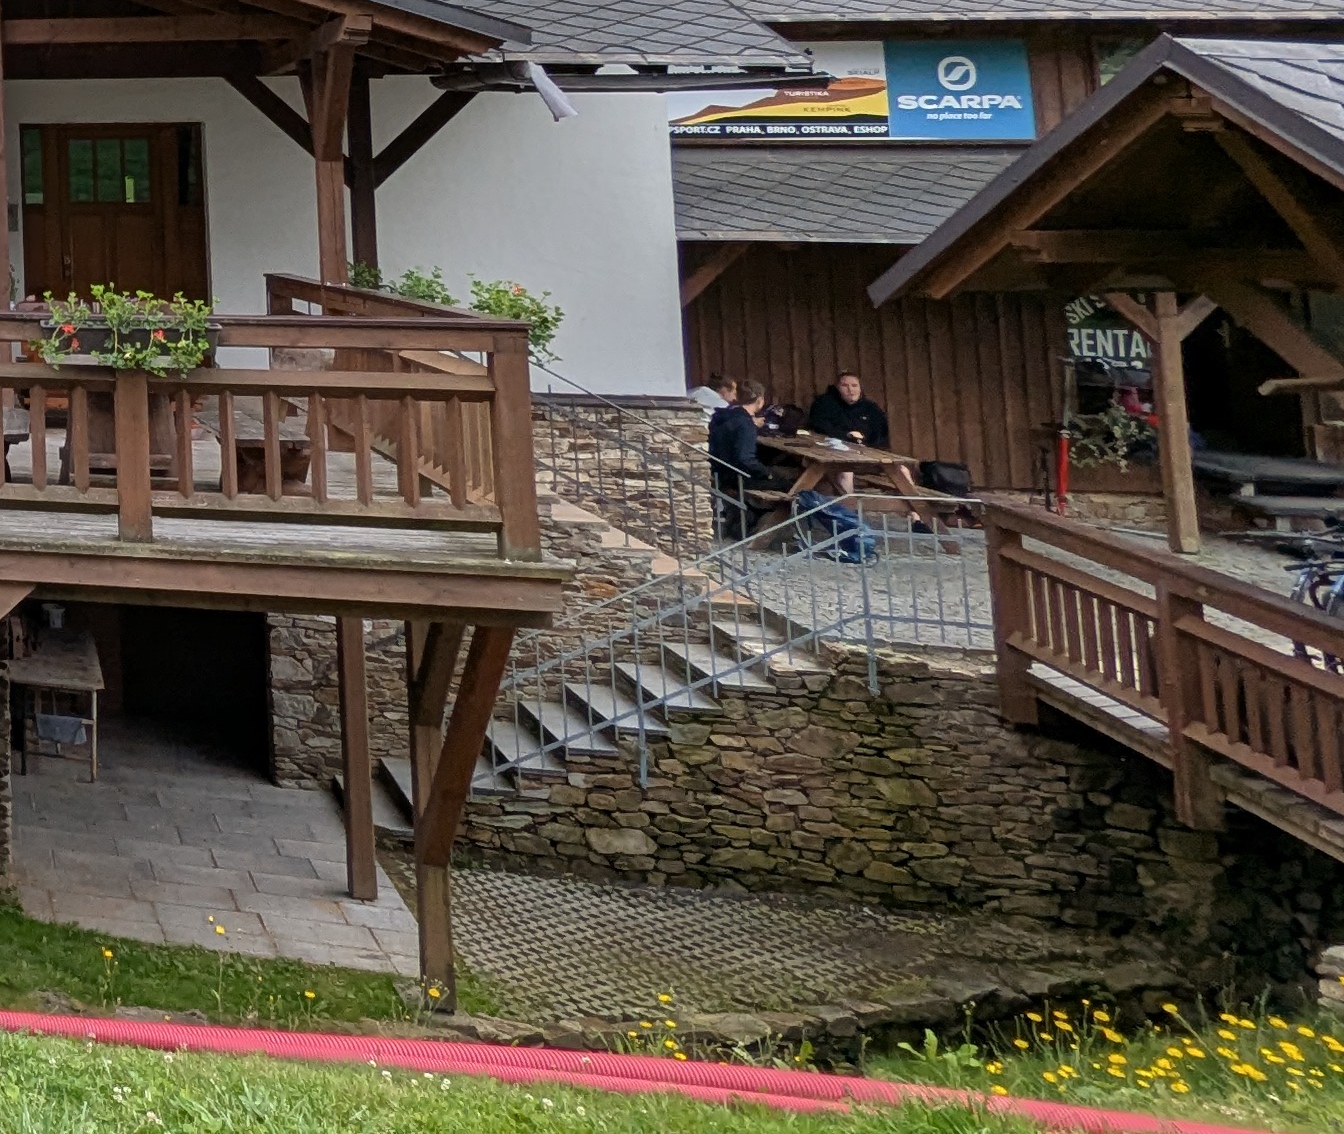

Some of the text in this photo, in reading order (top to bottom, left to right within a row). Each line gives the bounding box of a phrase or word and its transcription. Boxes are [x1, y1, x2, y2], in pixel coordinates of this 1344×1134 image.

[897, 95, 1023, 110] SCARPA
[963, 112, 979, 120] too
[725, 126, 765, 135] PRAHA,
[766, 126, 800, 135] BRNO,
[801, 126, 852, 135] OSTRAVA,
[853, 126, 888, 134] ESHOP
[1064, 296, 1095, 324] SKI
